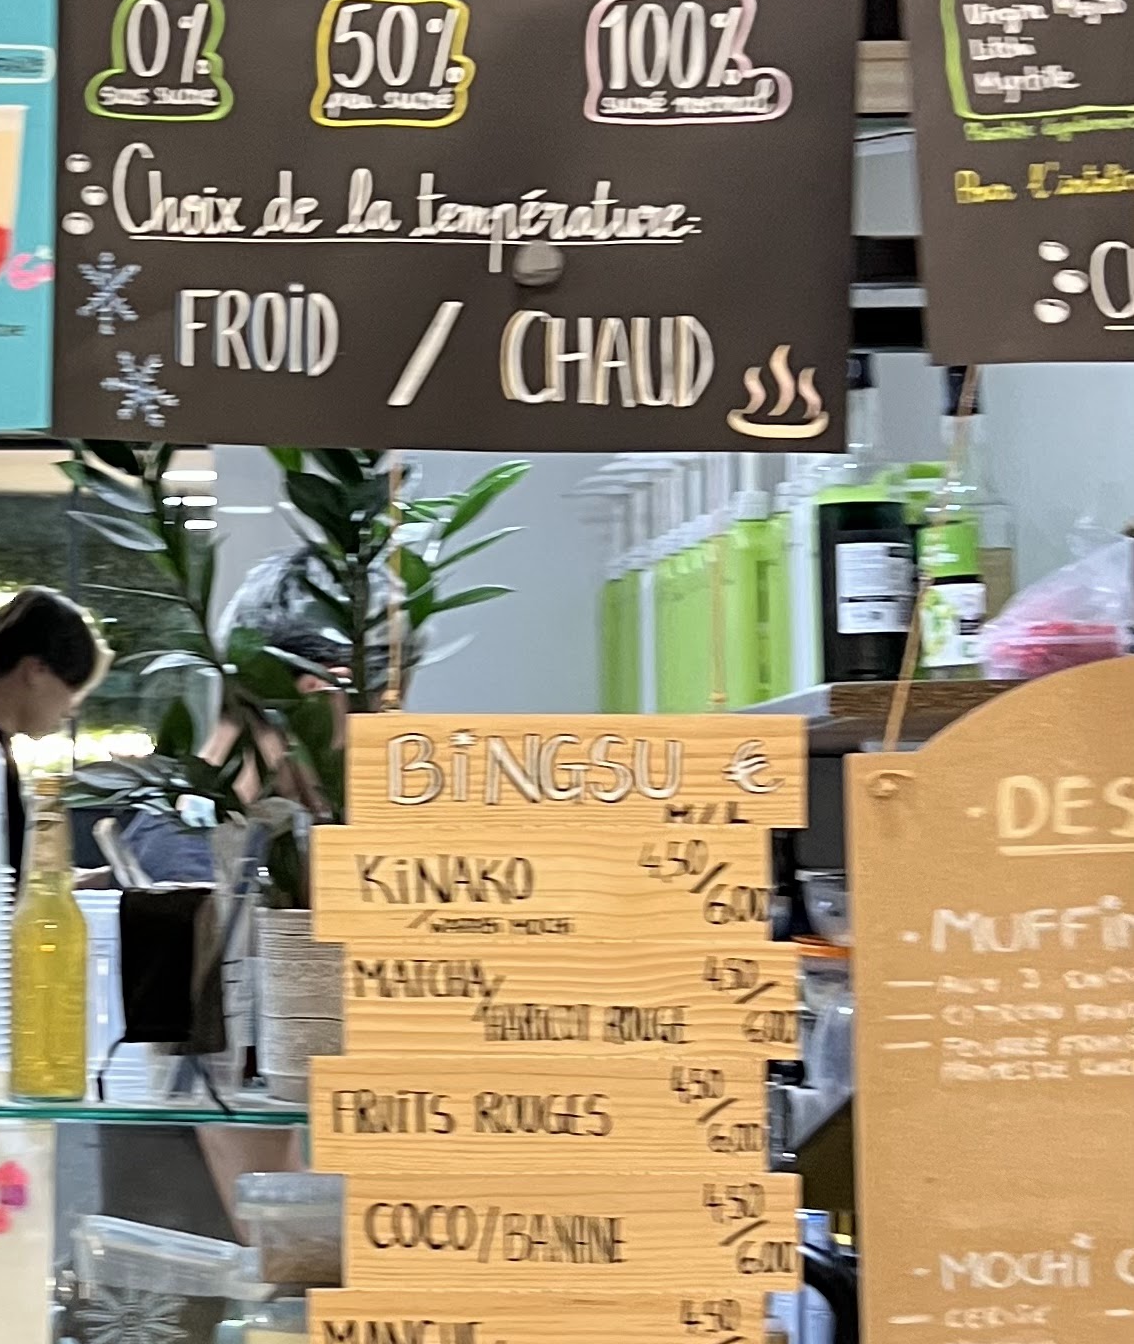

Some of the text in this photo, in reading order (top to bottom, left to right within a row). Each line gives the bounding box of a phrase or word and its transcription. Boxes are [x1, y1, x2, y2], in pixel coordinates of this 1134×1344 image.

[125, 0, 212, 85] 0%
[332, 2, 466, 90] 50%
[599, 1, 743, 89] 100%
[112, 142, 245, 236] Choix
[253, 170, 322, 236] de
[337, 168, 401, 235] la
[500, 309, 716, 408] CHAUD
[722, 739, 785, 795] €
[603, 1006, 694, 1045] ROUGE
[474, 1090, 613, 1138] ROUGES
